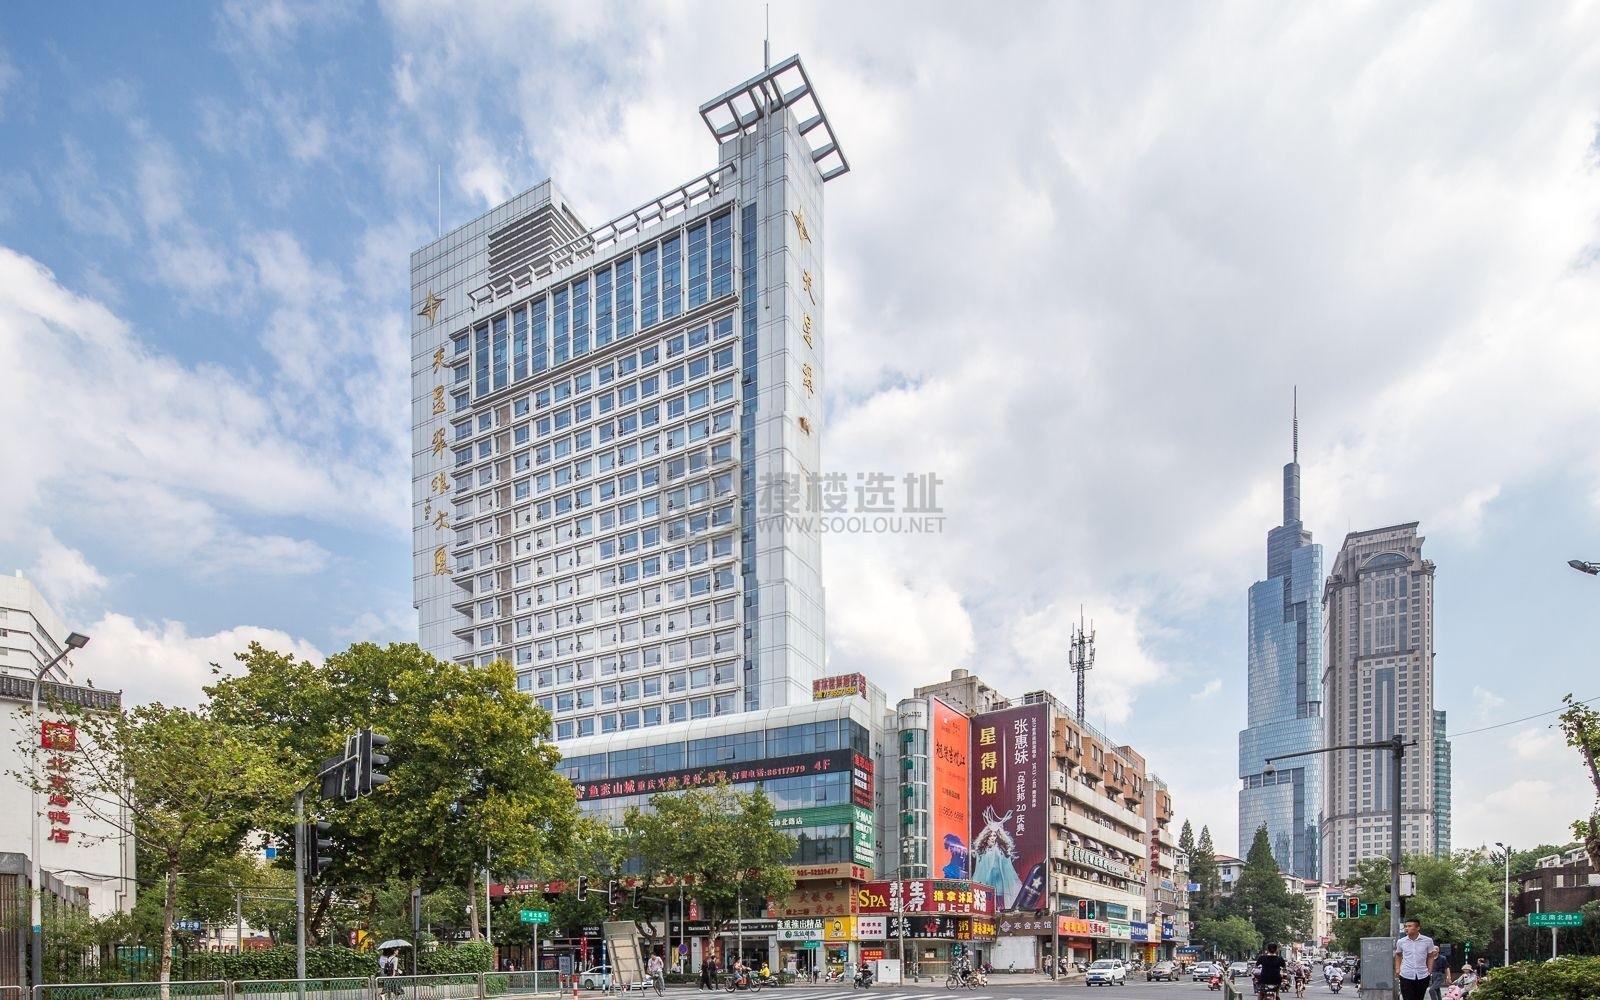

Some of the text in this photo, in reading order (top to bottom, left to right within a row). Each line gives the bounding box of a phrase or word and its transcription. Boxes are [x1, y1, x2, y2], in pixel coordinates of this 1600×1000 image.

[1014, 719, 1029, 765] 张惠妹
[813, 759, 831, 771] 4F
[980, 726, 997, 796] 星得斯
[859, 889, 887, 908] SPA
